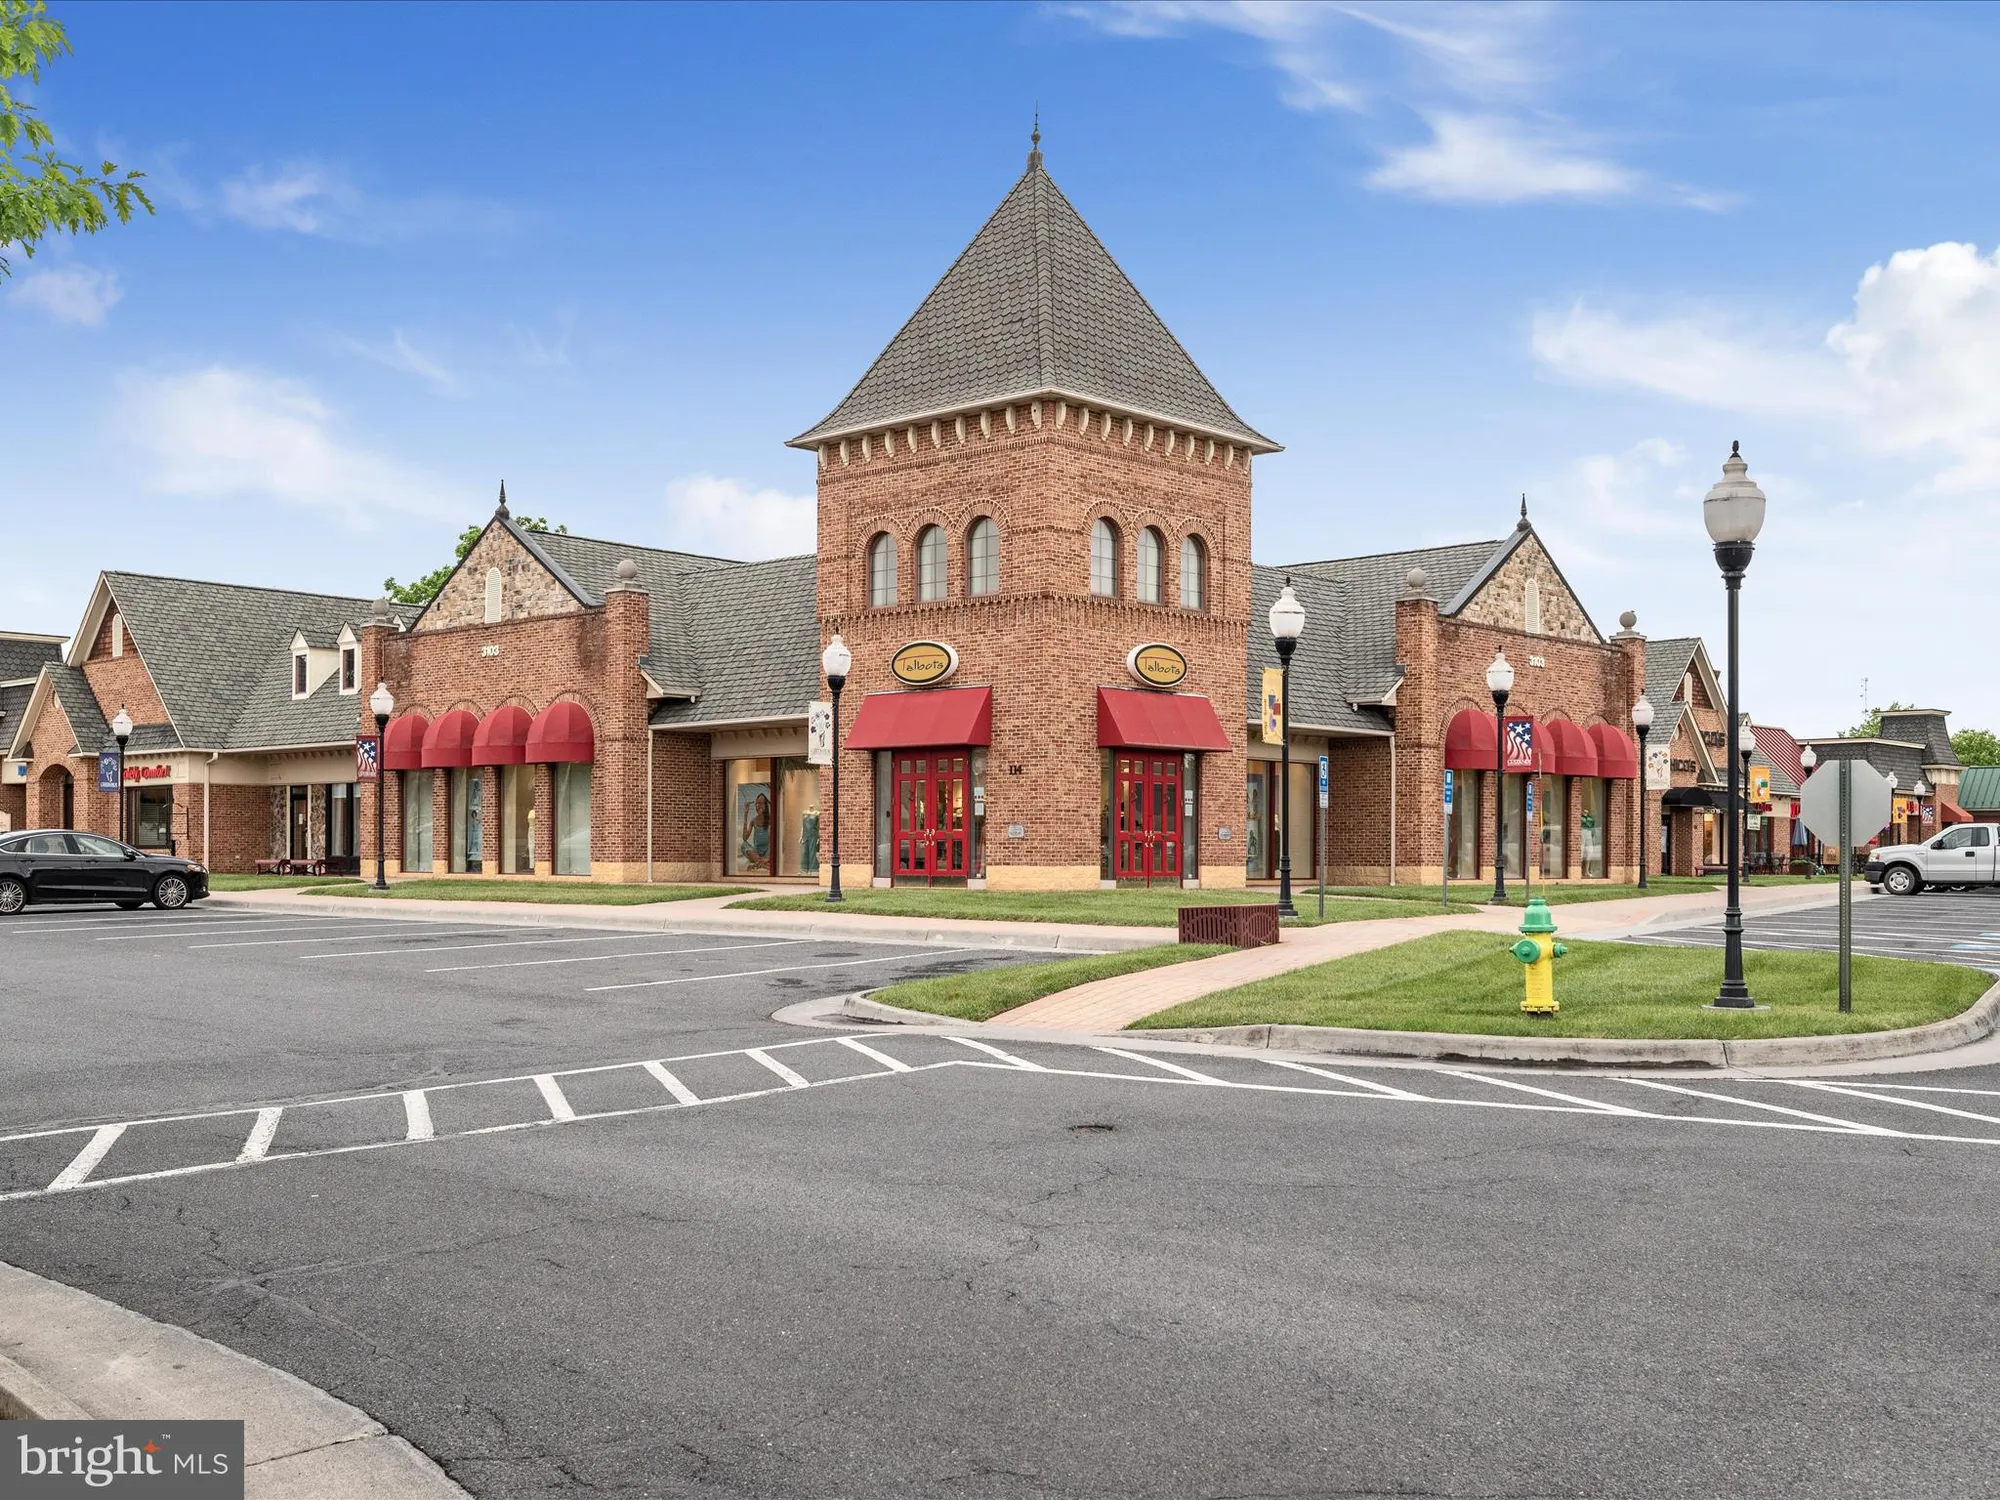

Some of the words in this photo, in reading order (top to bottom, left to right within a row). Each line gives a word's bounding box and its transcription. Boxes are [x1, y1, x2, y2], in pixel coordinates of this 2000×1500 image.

[481, 645, 500, 658] 3103
[896, 654, 945, 672] Talbots
[1139, 656, 1182, 675] Talbots
[1669, 758, 1697, 773] HICO'S
